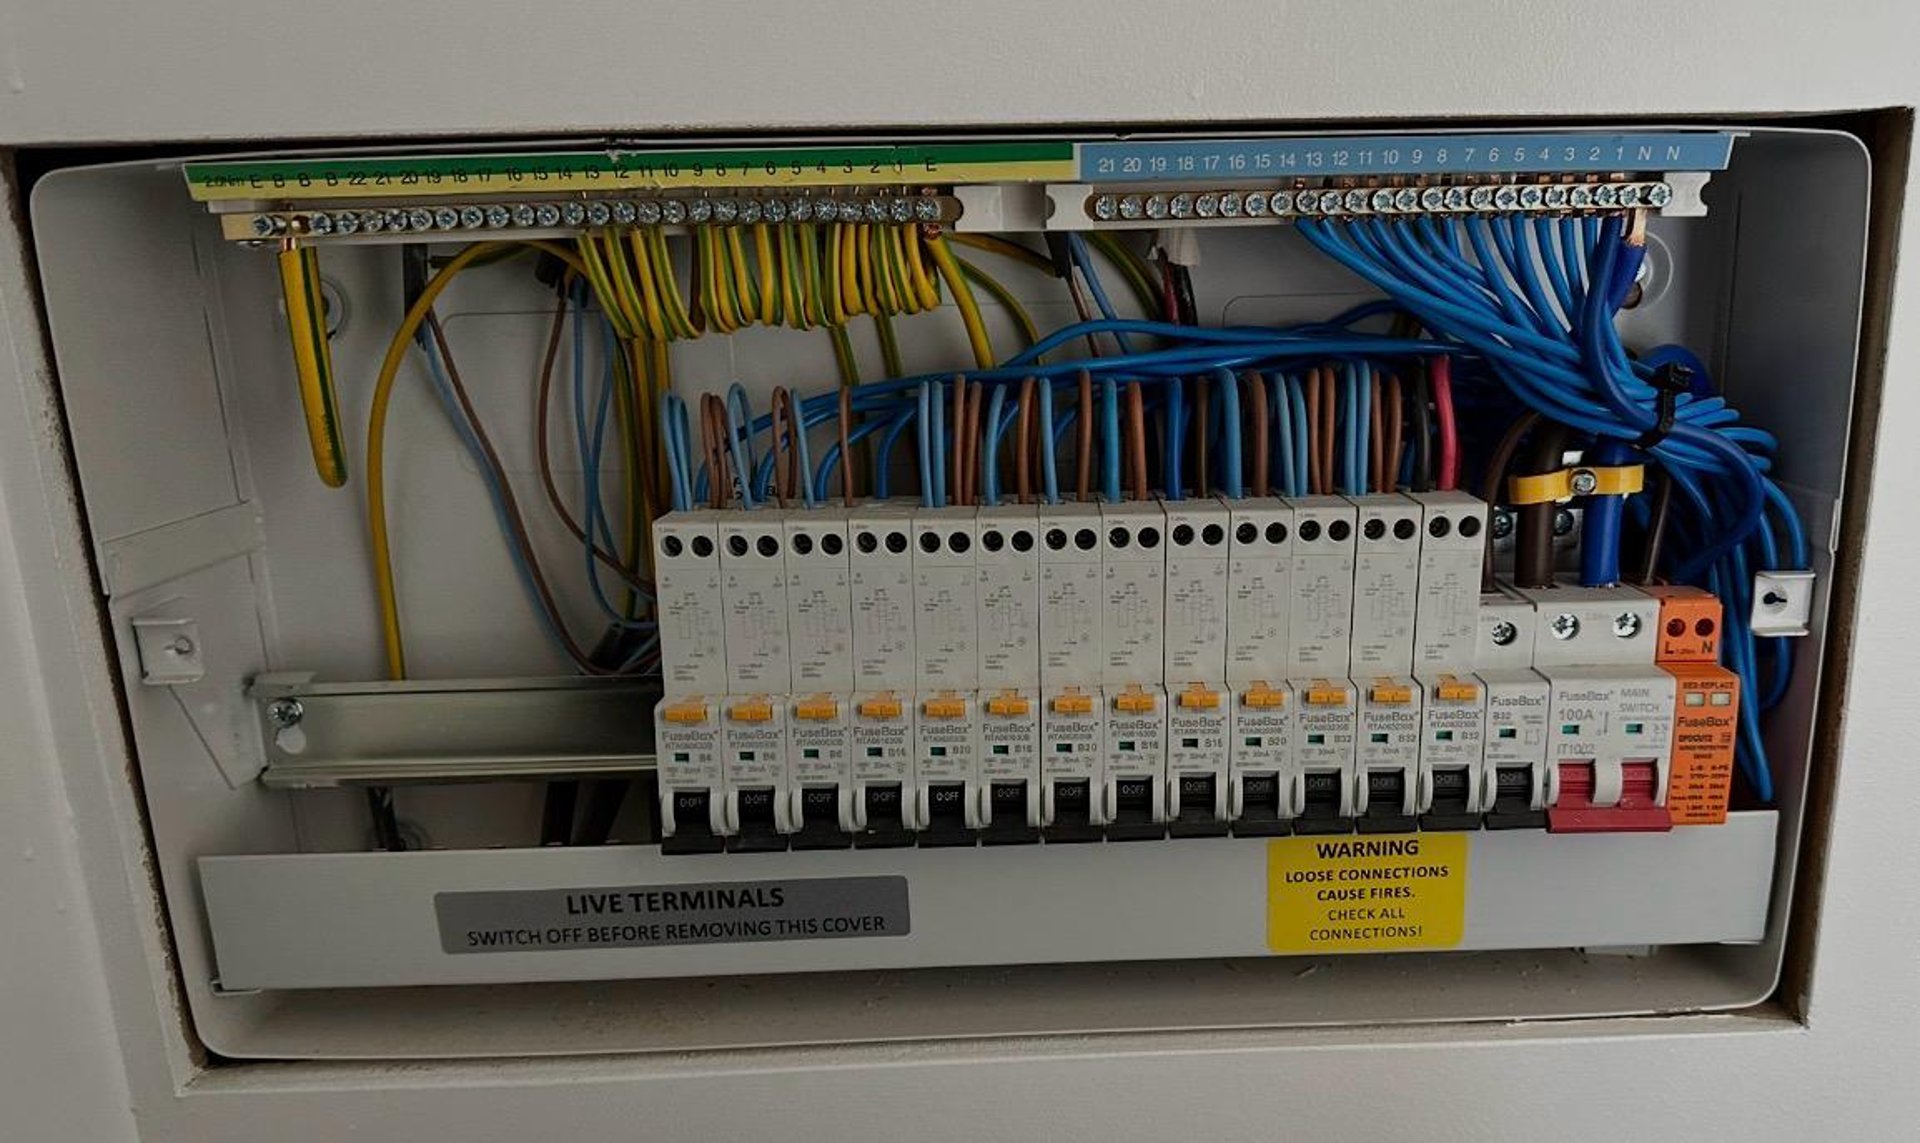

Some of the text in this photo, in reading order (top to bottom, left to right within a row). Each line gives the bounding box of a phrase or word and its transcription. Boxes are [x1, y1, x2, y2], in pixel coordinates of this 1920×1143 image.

[1099, 146, 1680, 172] 21 20 19 18 17 16 15 14 13 12 11 10 9 8 7 6 5 4 3 2 1 N N
[349, 172, 367, 186] 22
[376, 172, 391, 185] 21
[401, 171, 419, 184] 20
[427, 170, 442, 184] 19
[453, 169, 468, 182] 18
[477, 168, 492, 182] 17
[506, 168, 522, 181] 16
[532, 167, 548, 181] 15
[558, 167, 572, 180] 14
[585, 165, 600, 179] 13
[614, 165, 628, 178] 12
[640, 165, 653, 177] 11
[664, 164, 679, 177] 10
[693, 163, 703, 176] 9
[716, 163, 726, 176] 8
[742, 162, 750, 175] 7
[766, 161, 776, 175] 6
[791, 161, 801, 175] 5
[816, 160, 827, 174] 4
[843, 160, 853, 174] 3
[871, 160, 880, 173] 2
[926, 158, 936, 171] E
[1665, 642, 1674, 654] L
[1702, 641, 1712, 653] N
[1621, 689, 1649, 697] MAIN
[1559, 709, 1593, 720] 100A
[1620, 703, 1659, 712] SWITCH
[1078, 743, 1097, 752] B20
[1268, 736, 1287, 746] B20
[1316, 839, 1419, 859] WARNING
[1285, 866, 1449, 883] LOOSE CONNECTIONS
[1317, 886, 1415, 901] CAUSE FIRES.
[567, 887, 785, 915] LIVE TERMINALS
[1328, 907, 1405, 921] CHECK ALL
[467, 915, 885, 947] SWITCH OFF BEFORE REMOVING THIS COVER
[1310, 925, 1422, 941] CONNECTIONS!
